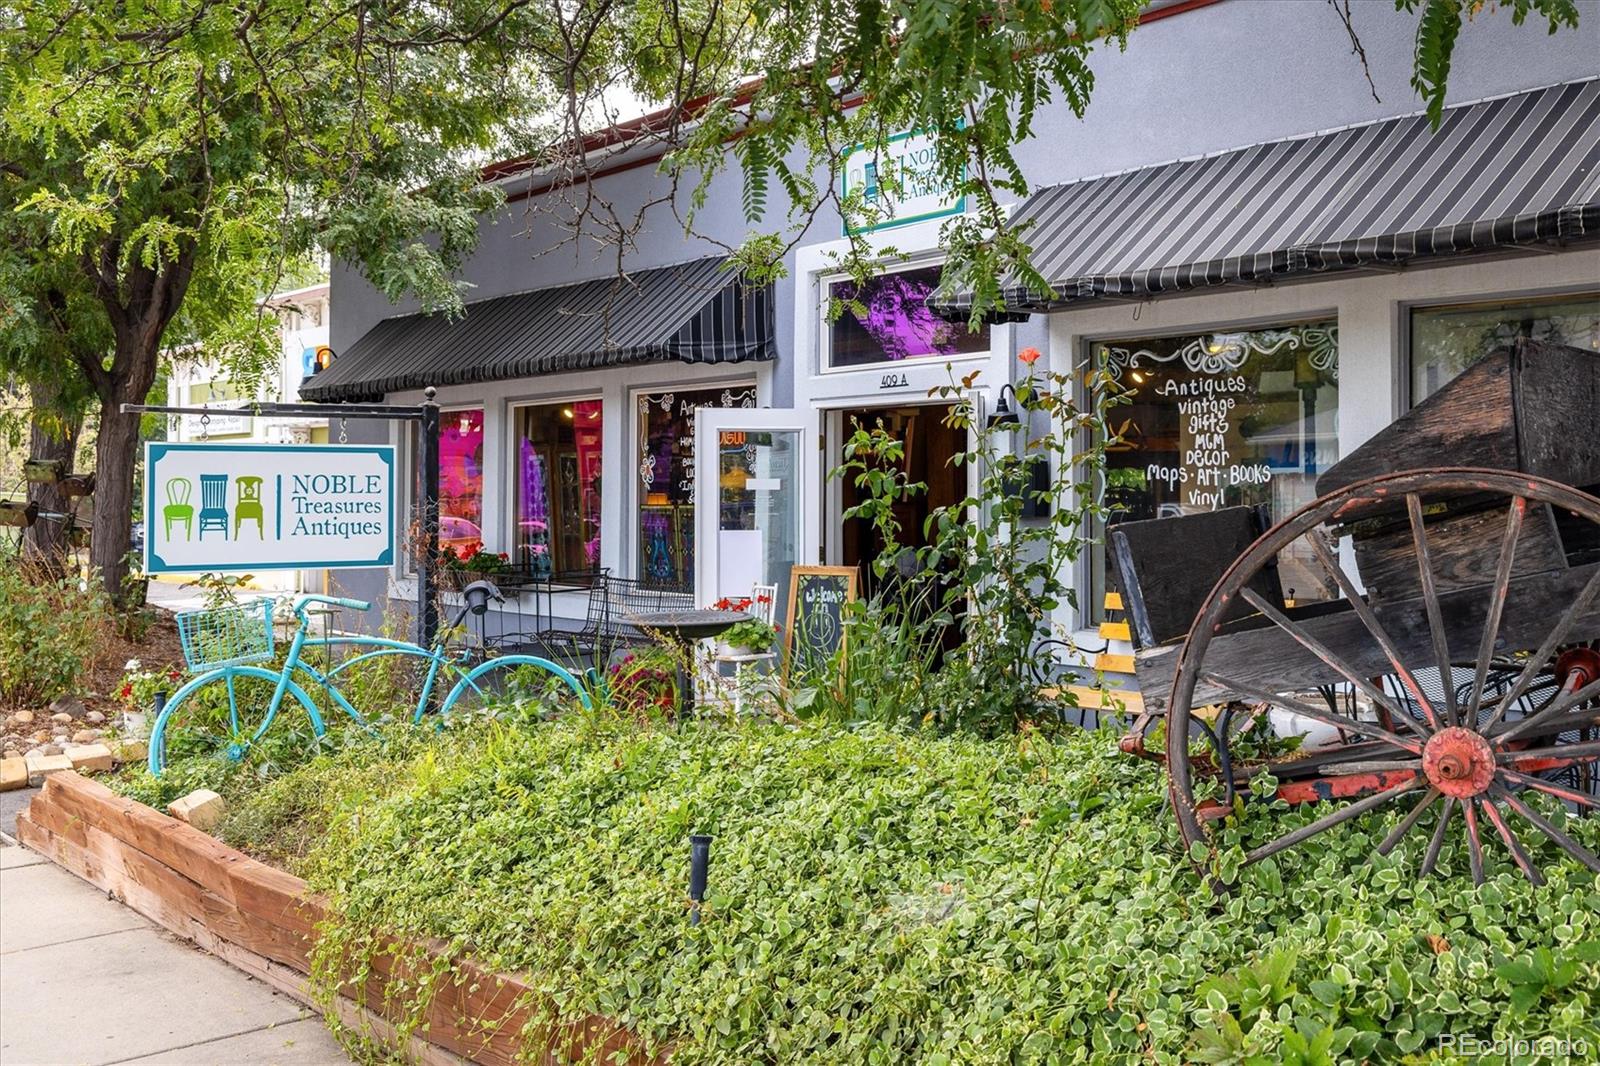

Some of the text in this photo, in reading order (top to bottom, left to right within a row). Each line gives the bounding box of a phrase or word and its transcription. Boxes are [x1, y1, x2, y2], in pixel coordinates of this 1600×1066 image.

[881, 373, 908, 387] 409 A
[1163, 375, 1247, 401] Antiques
[1187, 415, 1230, 434] gifts
[1194, 433, 1226, 451] MCM
[291, 473, 382, 495] NOBLE
[1196, 467, 1221, 487] Art
[1229, 463, 1272, 486] BOOKS
[290, 495, 382, 515] Treasures
[1188, 487, 1226, 511] Vinyl
[290, 515, 382, 540] Antiques
